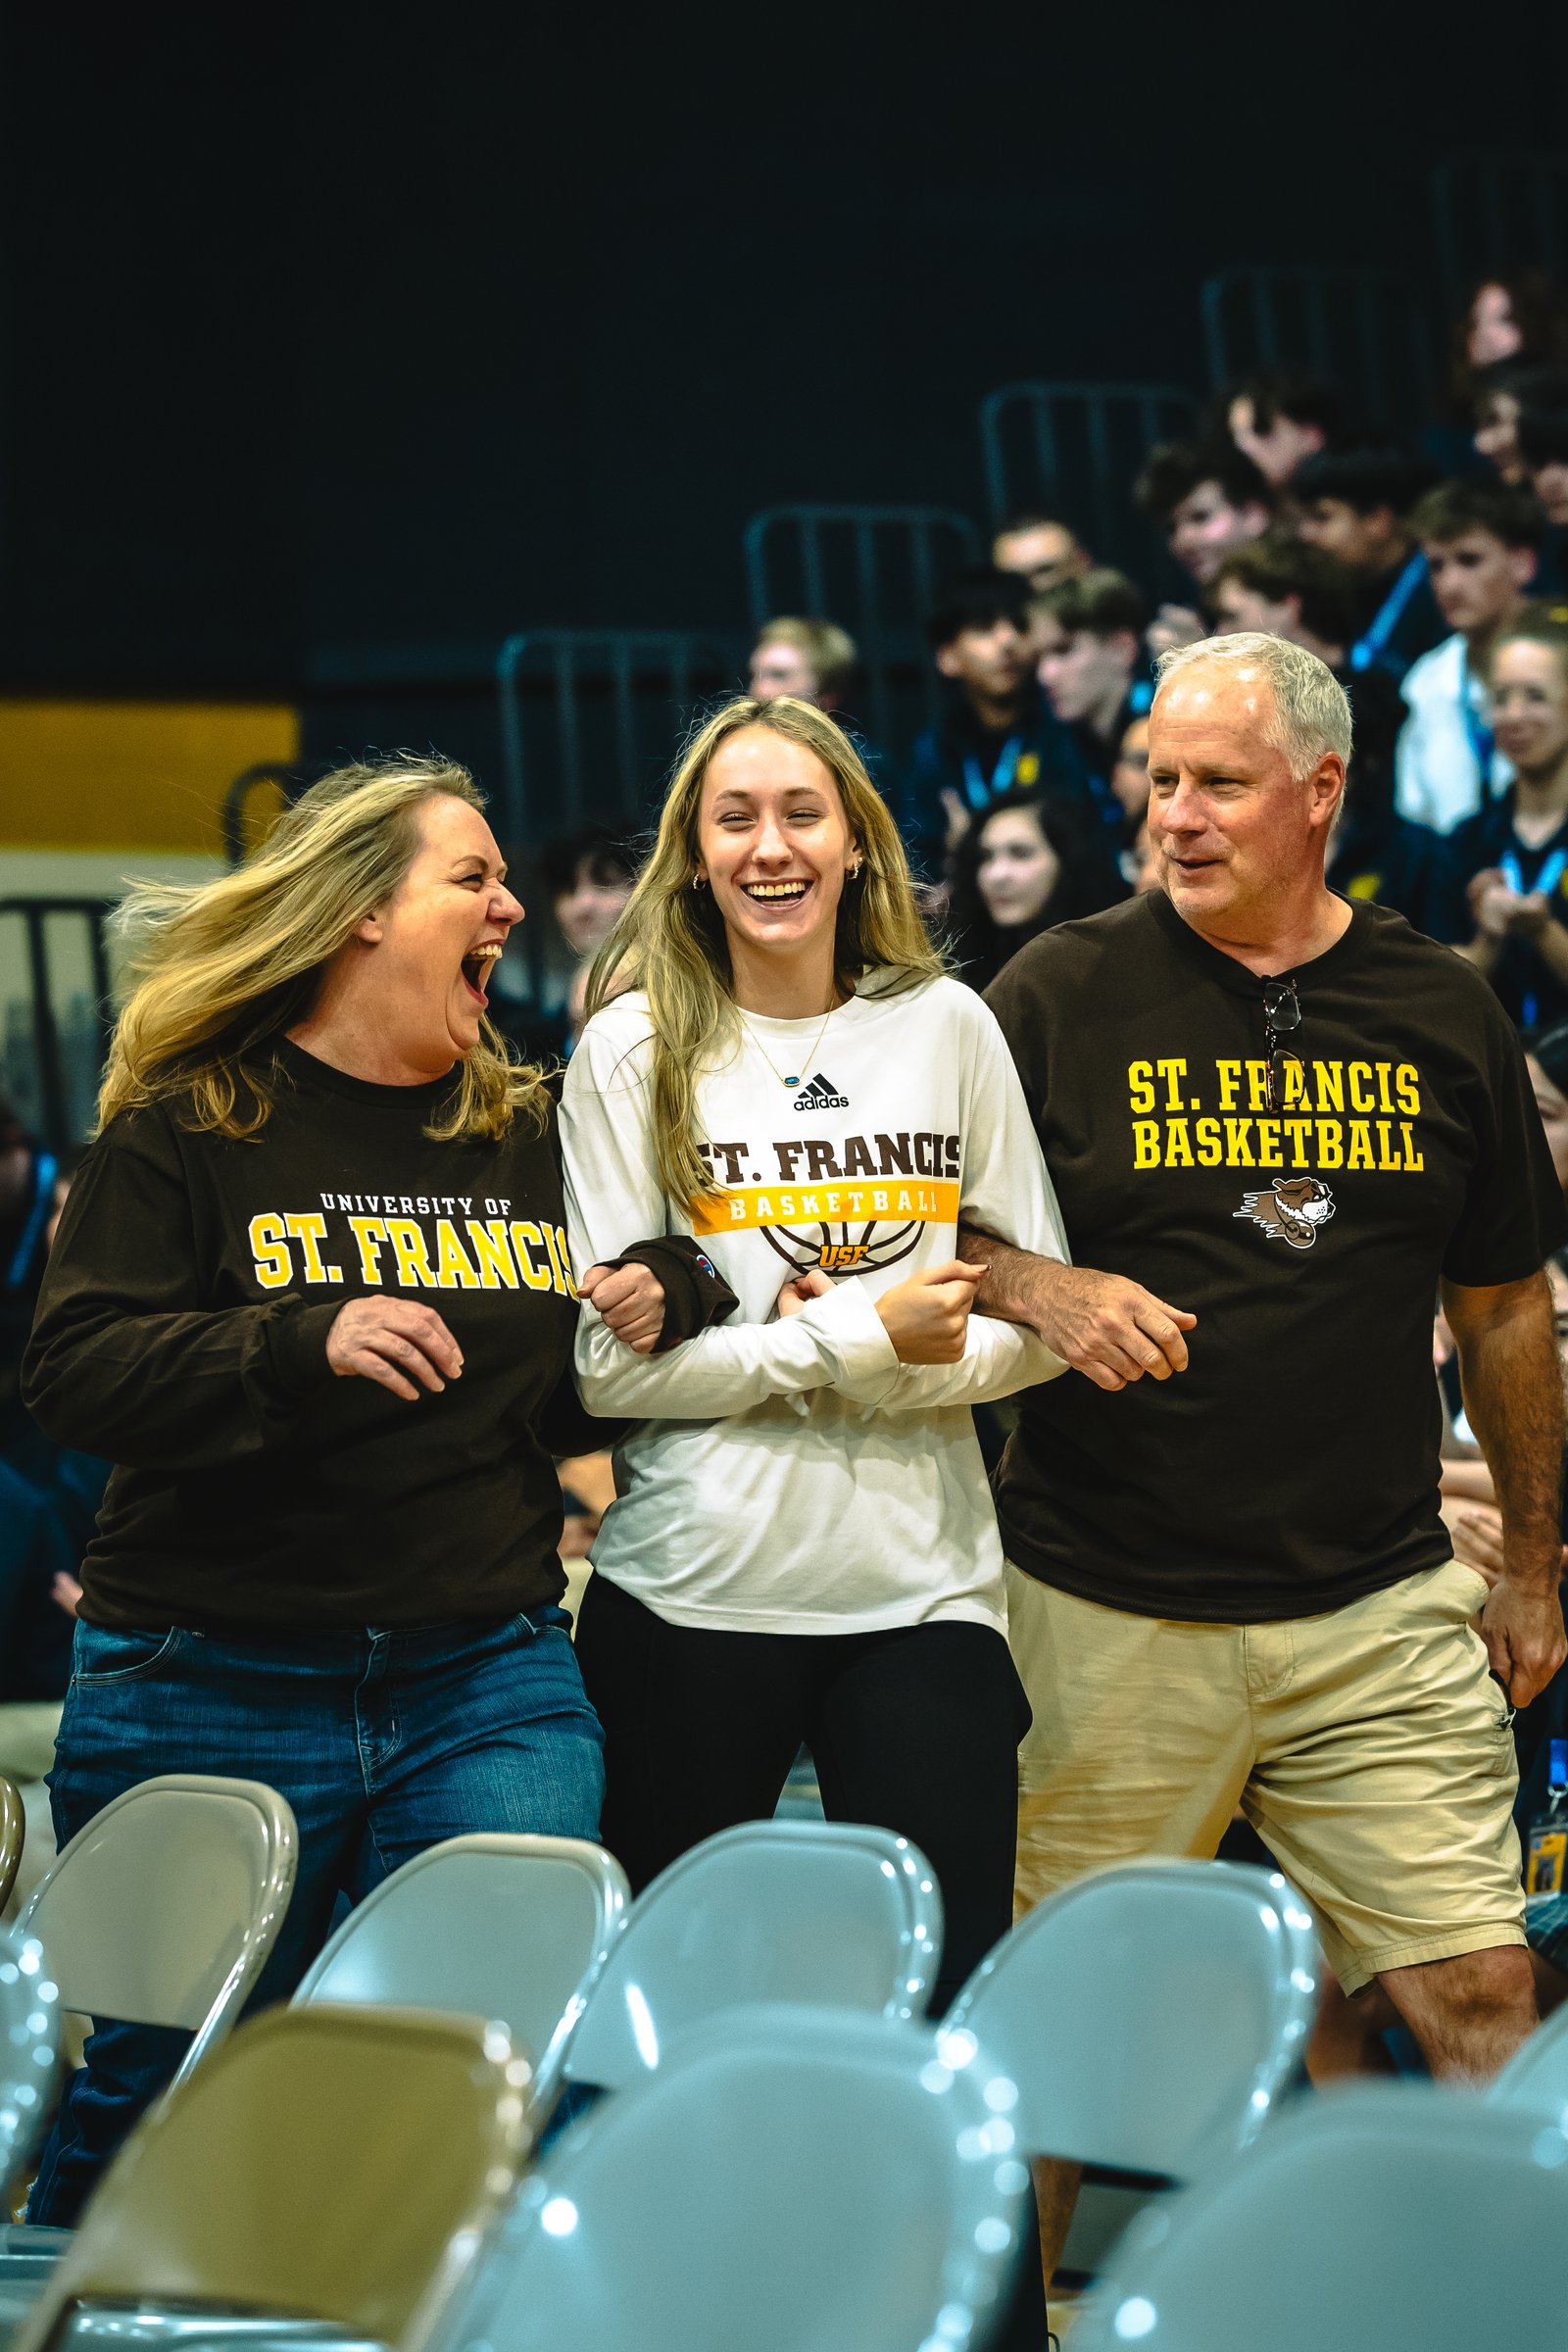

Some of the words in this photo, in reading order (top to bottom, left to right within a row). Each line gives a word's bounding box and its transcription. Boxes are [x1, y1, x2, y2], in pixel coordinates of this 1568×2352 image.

[793, 1095, 850, 1111] adidas
[1128, 1058, 1200, 1114] ST.
[772, 1132, 960, 1181] FRANCIS
[1132, 1117, 1424, 1171] BASKETBALL
[319, 1193, 472, 1215] UNIVERSITY
[484, 1198, 512, 1216] OF
[248, 1212, 344, 1289] ST.
[819, 1245, 869, 1268] USF
